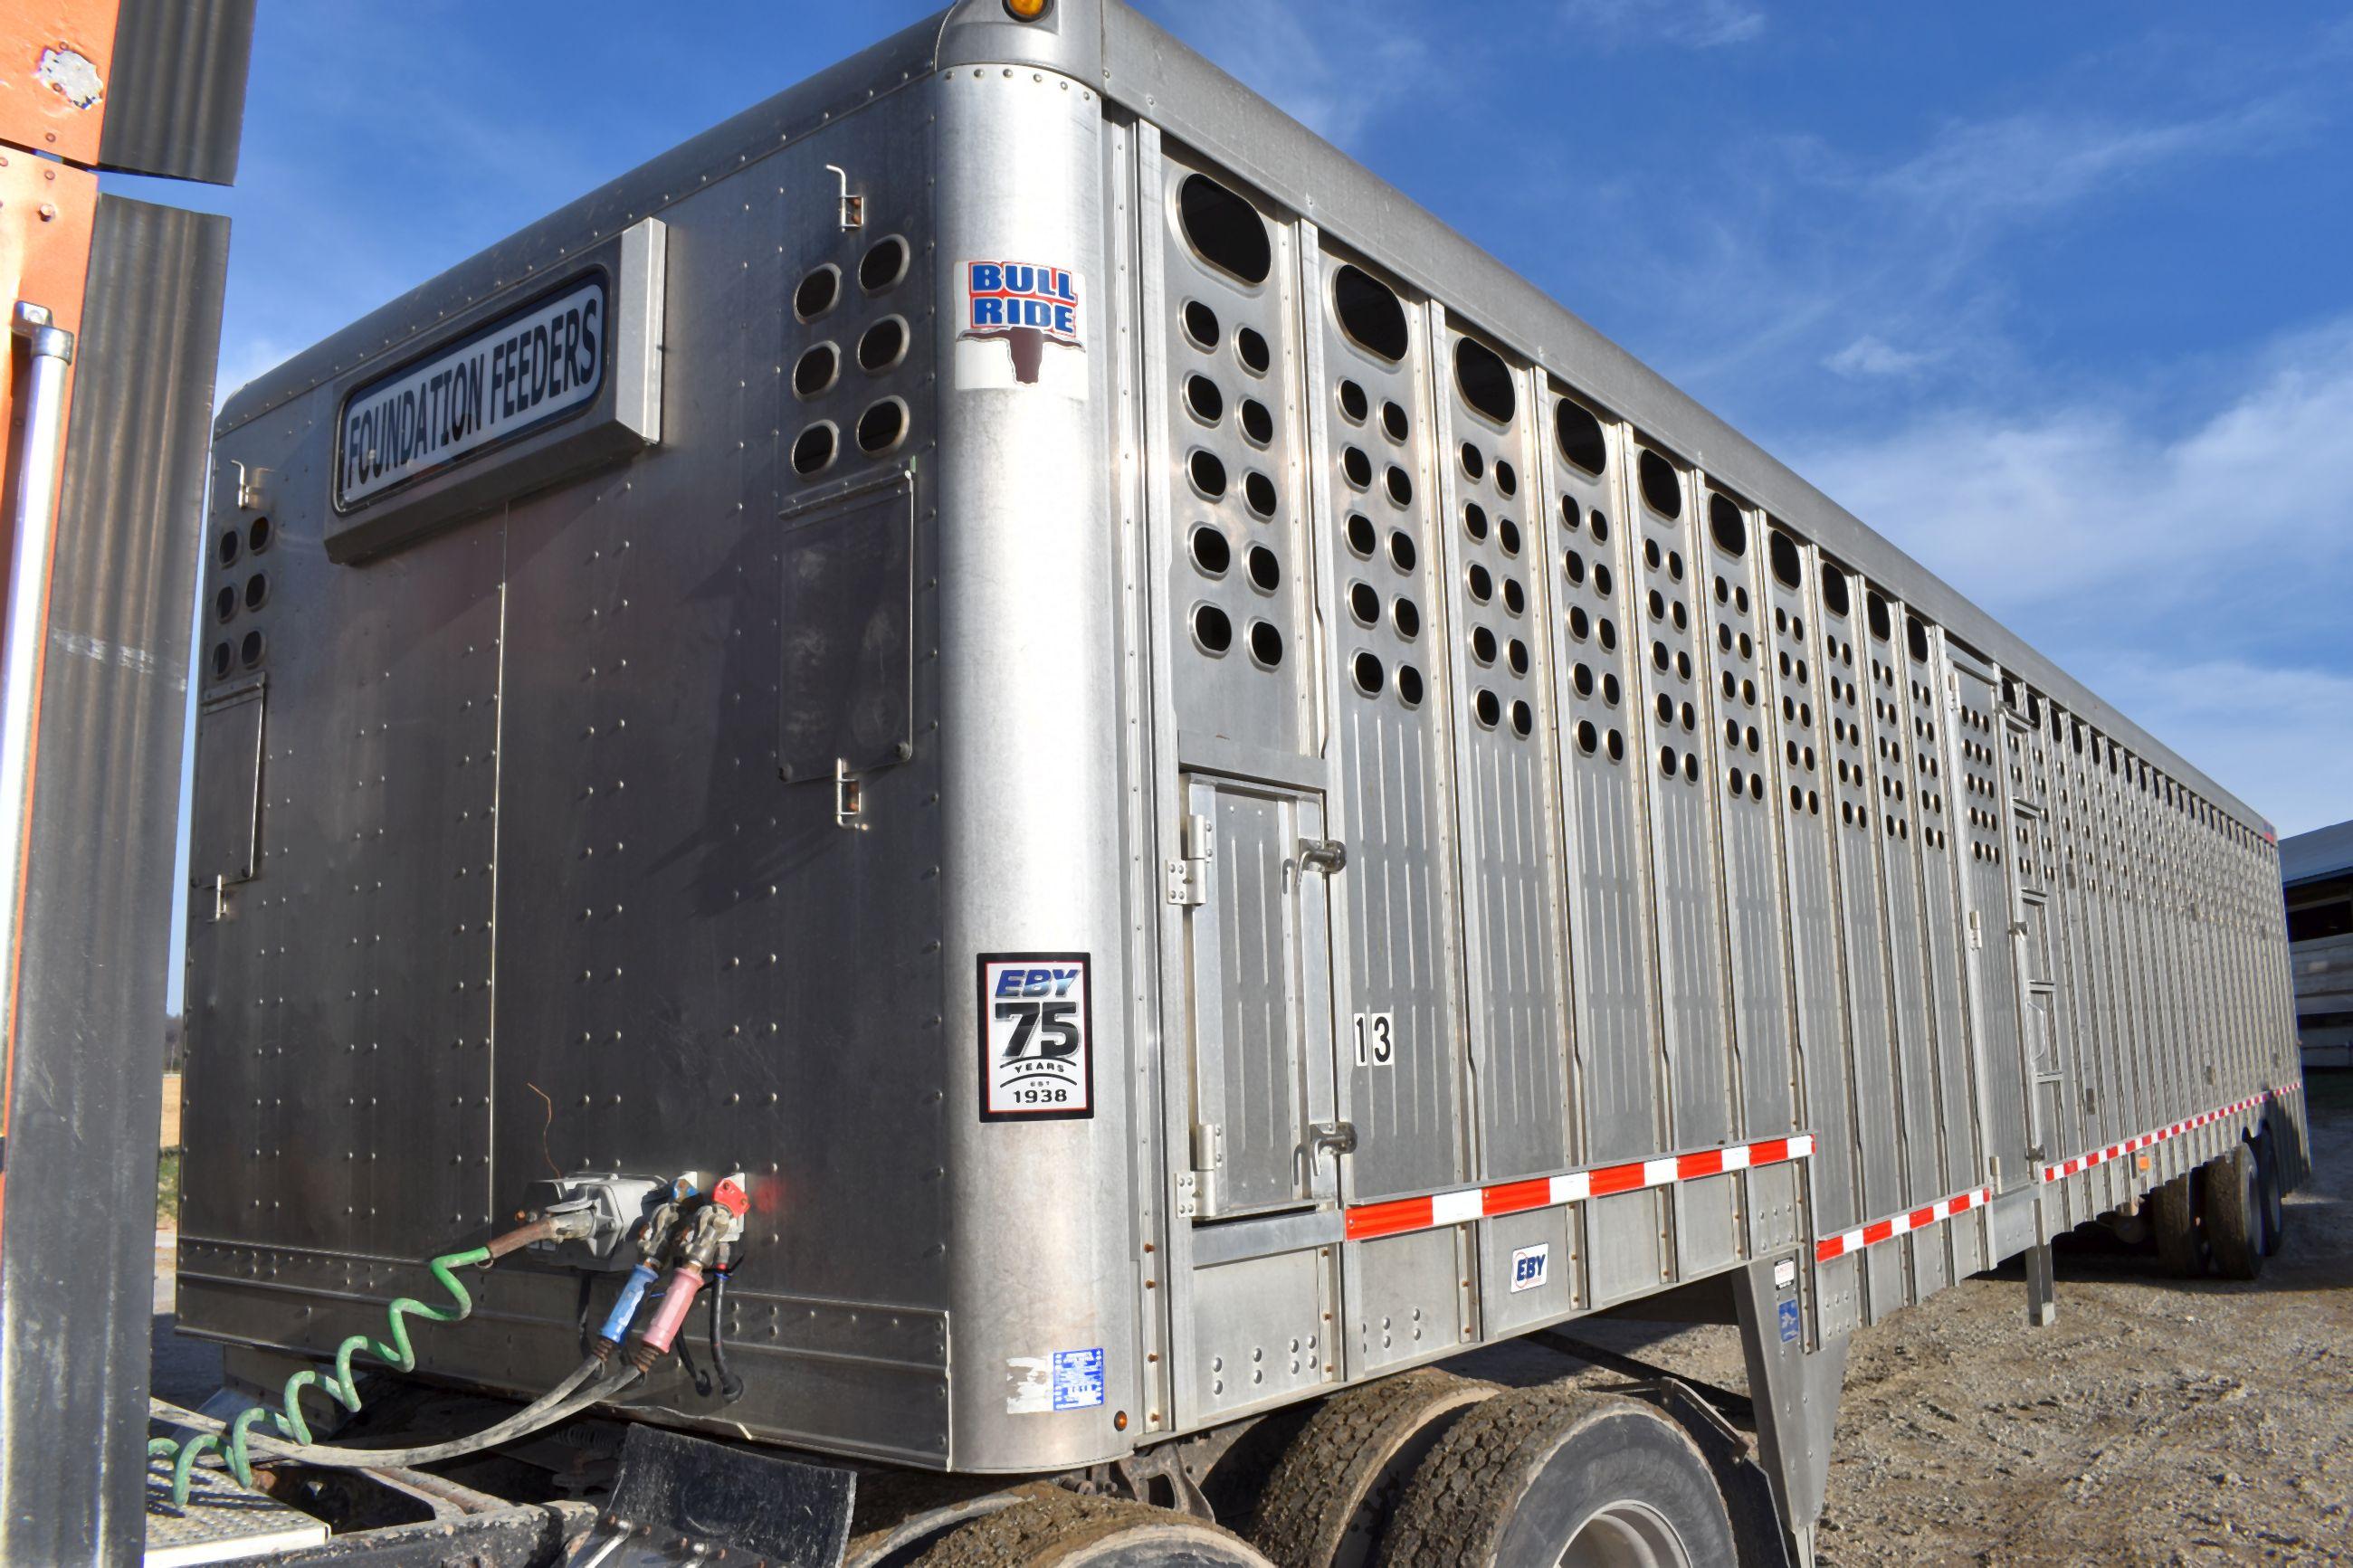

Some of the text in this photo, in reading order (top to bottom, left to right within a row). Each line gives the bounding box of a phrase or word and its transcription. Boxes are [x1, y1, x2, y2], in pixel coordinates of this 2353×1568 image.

[971, 264, 1075, 300] BULL
[973, 298, 1073, 334] RIDE
[348, 298, 597, 489] FOUNDATION FEEDERS
[996, 969, 1081, 998] EBY
[995, 1002, 1081, 1058] 75
[1356, 1016, 1391, 1063] 13
[1015, 1061, 1065, 1074] YEARS
[1014, 1088, 1067, 1104] 1938
[1516, 1254, 1546, 1281] EBY
